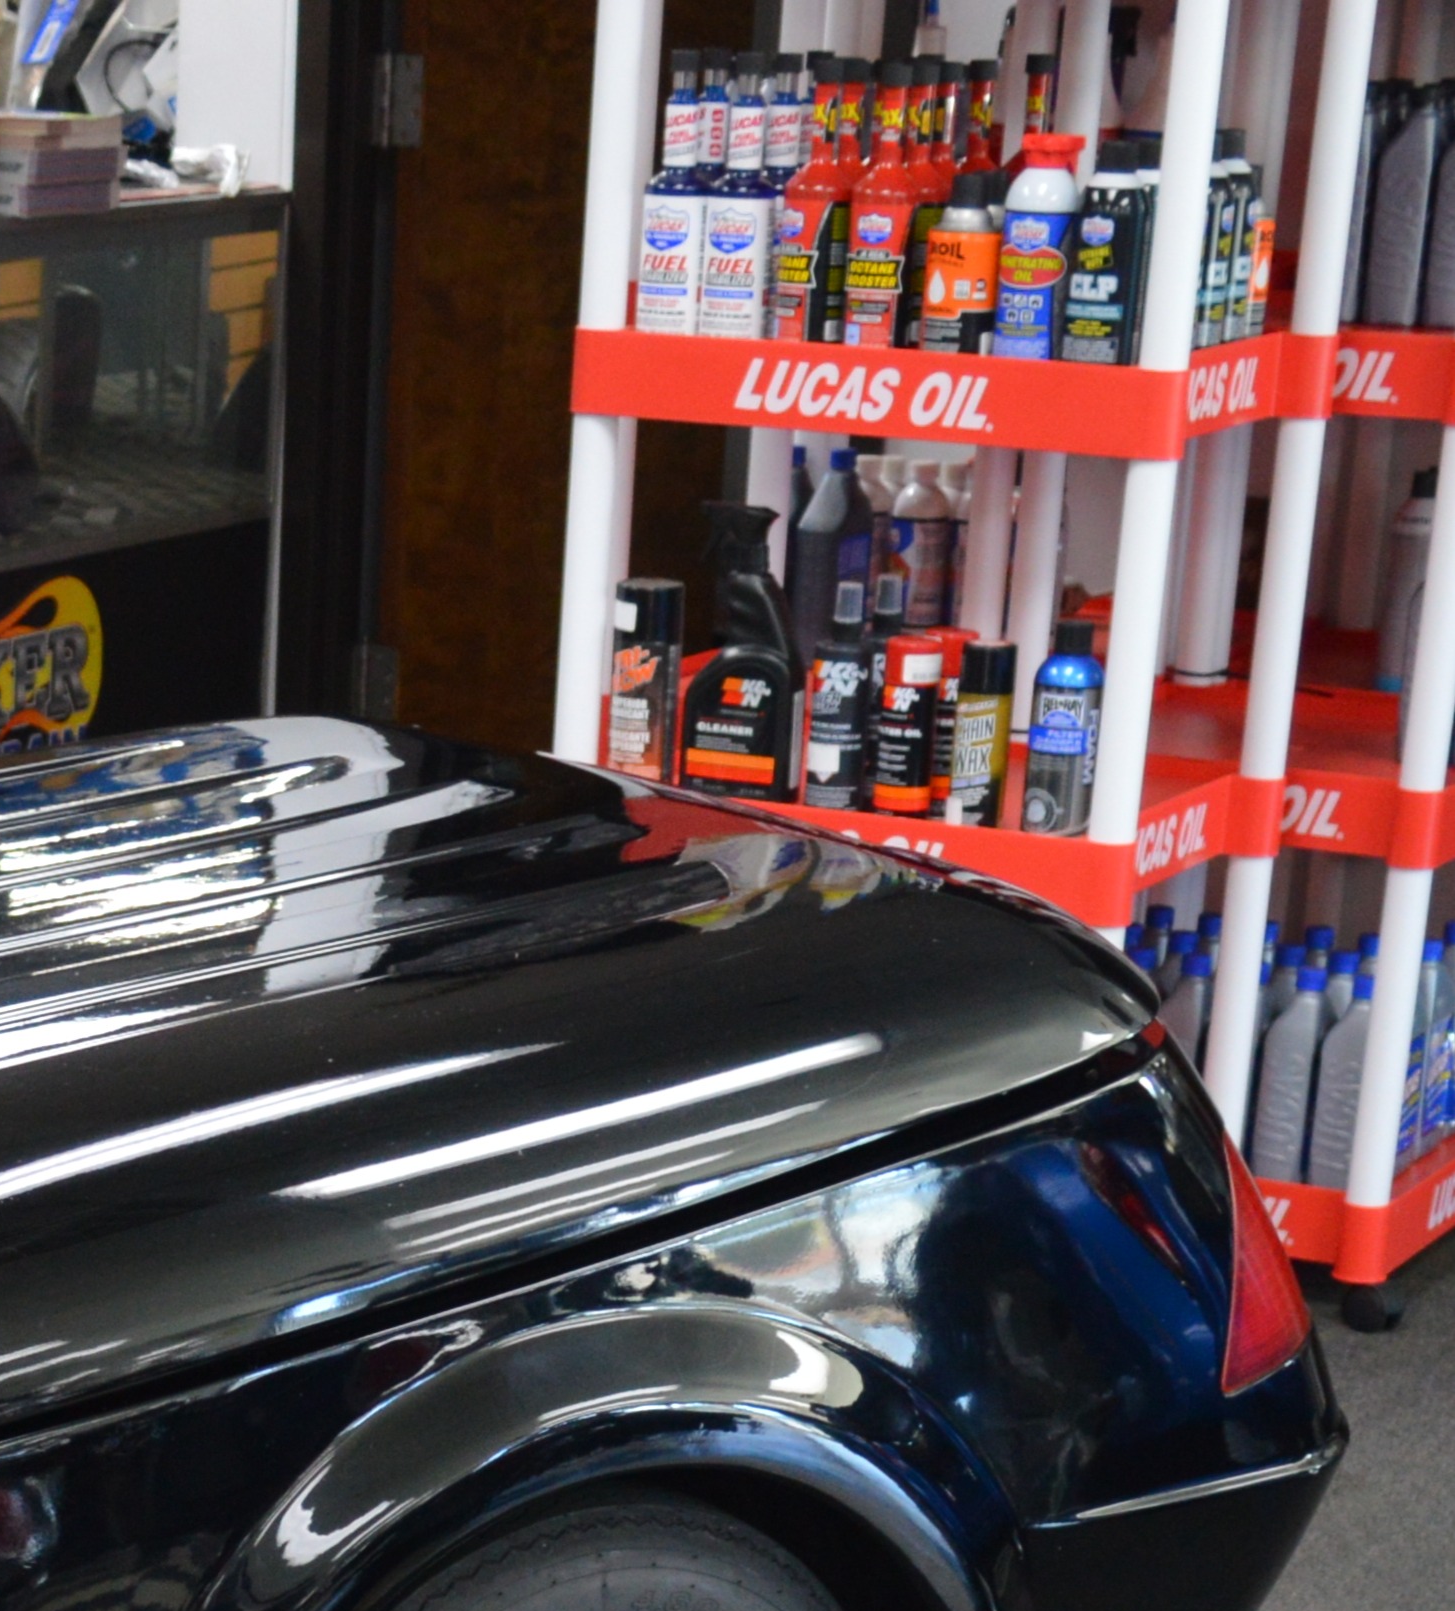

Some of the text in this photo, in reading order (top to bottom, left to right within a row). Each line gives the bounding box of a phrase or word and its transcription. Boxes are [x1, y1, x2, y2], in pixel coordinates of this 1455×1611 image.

[643, 253, 688, 273] FUEL
[708, 257, 754, 275] FUEL
[849, 260, 896, 275] OCTANE
[847, 274, 898, 288] BOOSTER
[1069, 272, 1119, 302] CLP
[734, 359, 893, 424] LUCAS
[1187, 356, 1258, 423] CAS OIL
[740, 678, 772, 708] K&N
[696, 720, 754, 738] CLEANER
[1135, 813, 1177, 877] CAS
